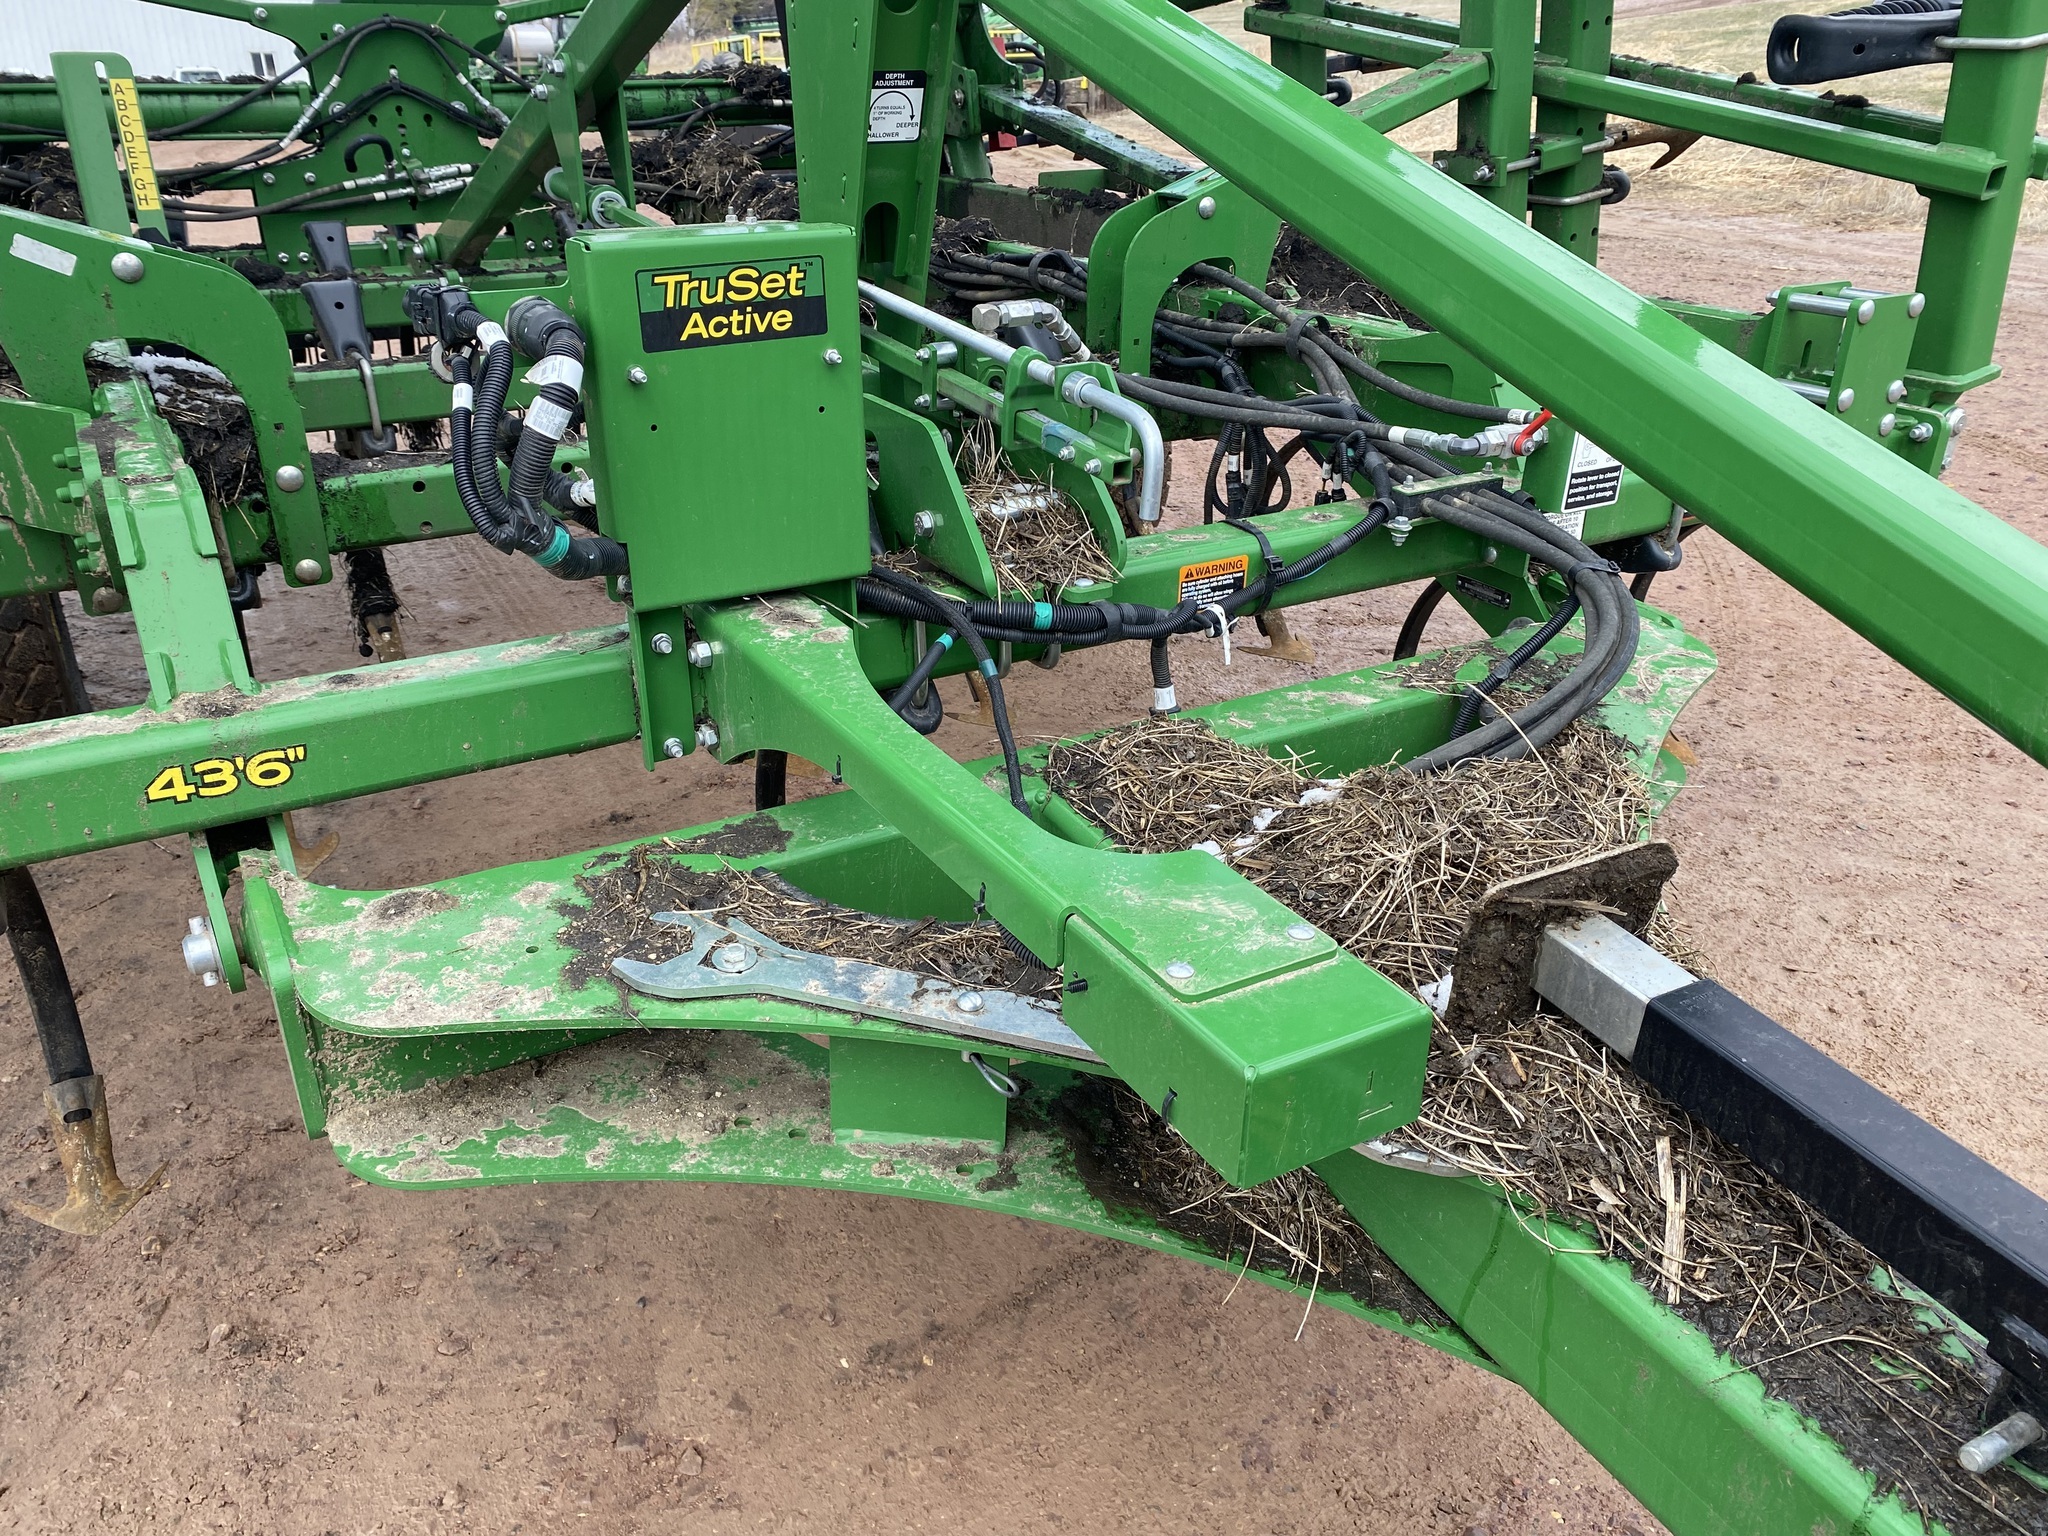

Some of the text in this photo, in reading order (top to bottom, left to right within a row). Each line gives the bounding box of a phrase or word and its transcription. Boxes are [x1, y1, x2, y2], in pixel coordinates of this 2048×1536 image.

[114, 83, 125, 95] A
[116, 99, 128, 111] B
[120, 115, 131, 127] C
[123, 131, 134, 143] D
[127, 147, 138, 159] E
[130, 163, 141, 174] F
[134, 178, 146, 190] G
[138, 194, 149, 206] H
[652, 264, 806, 308] TruSet
[680, 306, 793, 341] Active
[1577, 459, 1598, 467] CLOSED
[1569, 486, 1588, 495] position
[1195, 560, 1243, 577] WARNING
[146, 744, 306, 804] 43'6"
